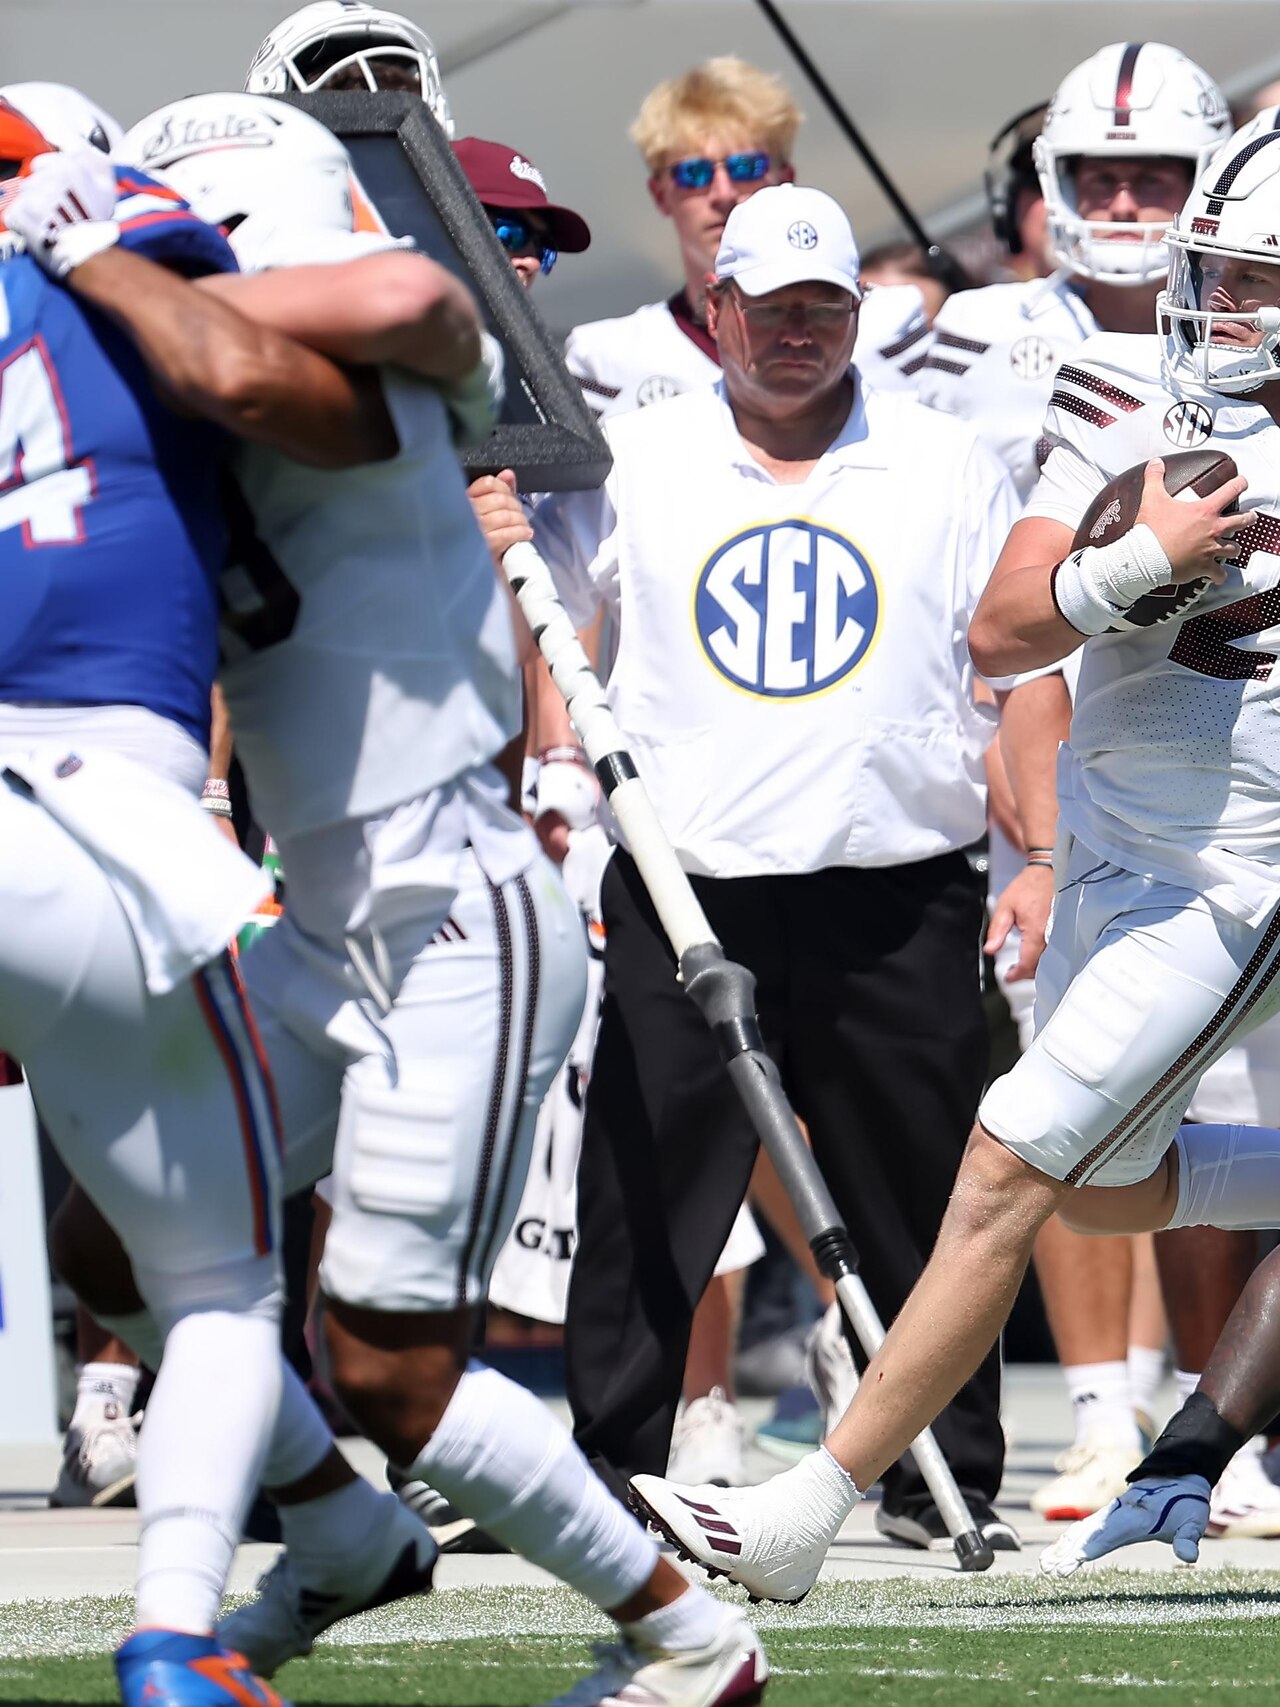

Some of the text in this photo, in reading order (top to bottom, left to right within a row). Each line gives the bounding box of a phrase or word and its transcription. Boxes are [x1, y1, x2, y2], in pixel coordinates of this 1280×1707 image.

[787, 220, 818, 250] SEC
[1163, 401, 1213, 448] SEC
[1089, 498, 1121, 539] State
[697, 520, 876, 696] SEC
